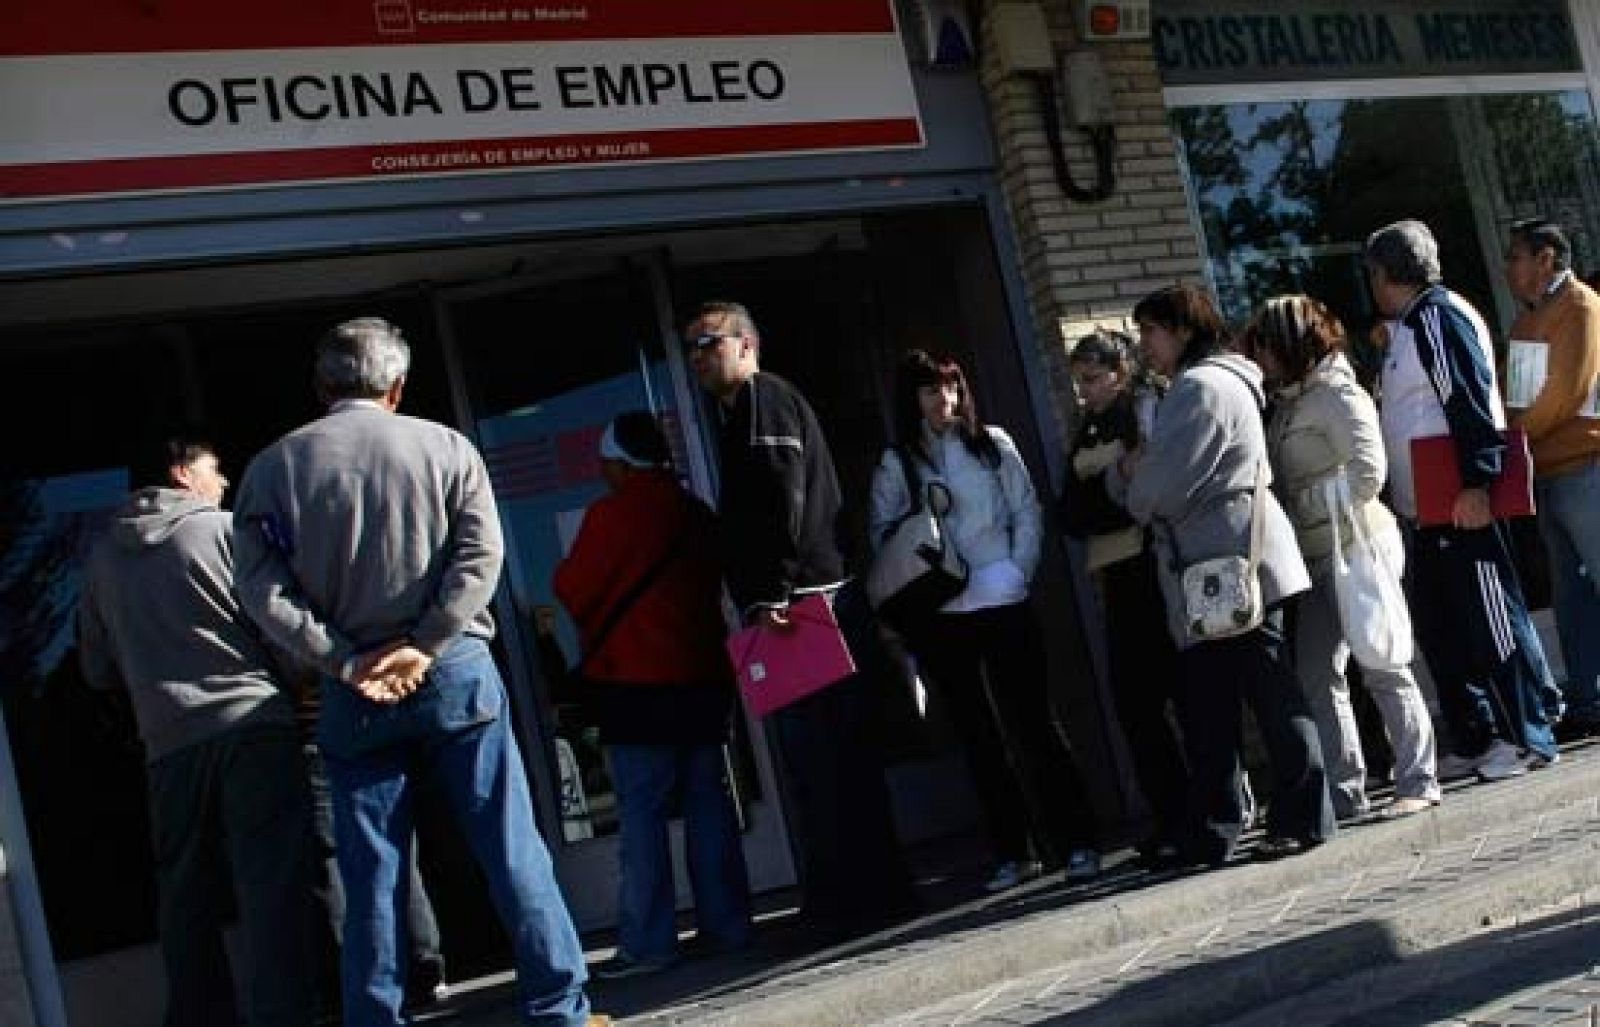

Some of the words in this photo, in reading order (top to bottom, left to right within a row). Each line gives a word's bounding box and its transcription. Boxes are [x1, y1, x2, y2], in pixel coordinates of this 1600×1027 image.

[419, 8, 507, 23] Comunidad
[512, 8, 530, 21] de
[534, 6, 588, 20] Madrid
[168, 74, 442, 126] OFICINA
[456, 69, 540, 112] DE
[556, 60, 785, 109] EMPLEO
[484, 149, 508, 164] DE
[511, 146, 577, 161] EMPLEO
[579, 145, 592, 157] Y
[595, 141, 650, 156] MUJER
